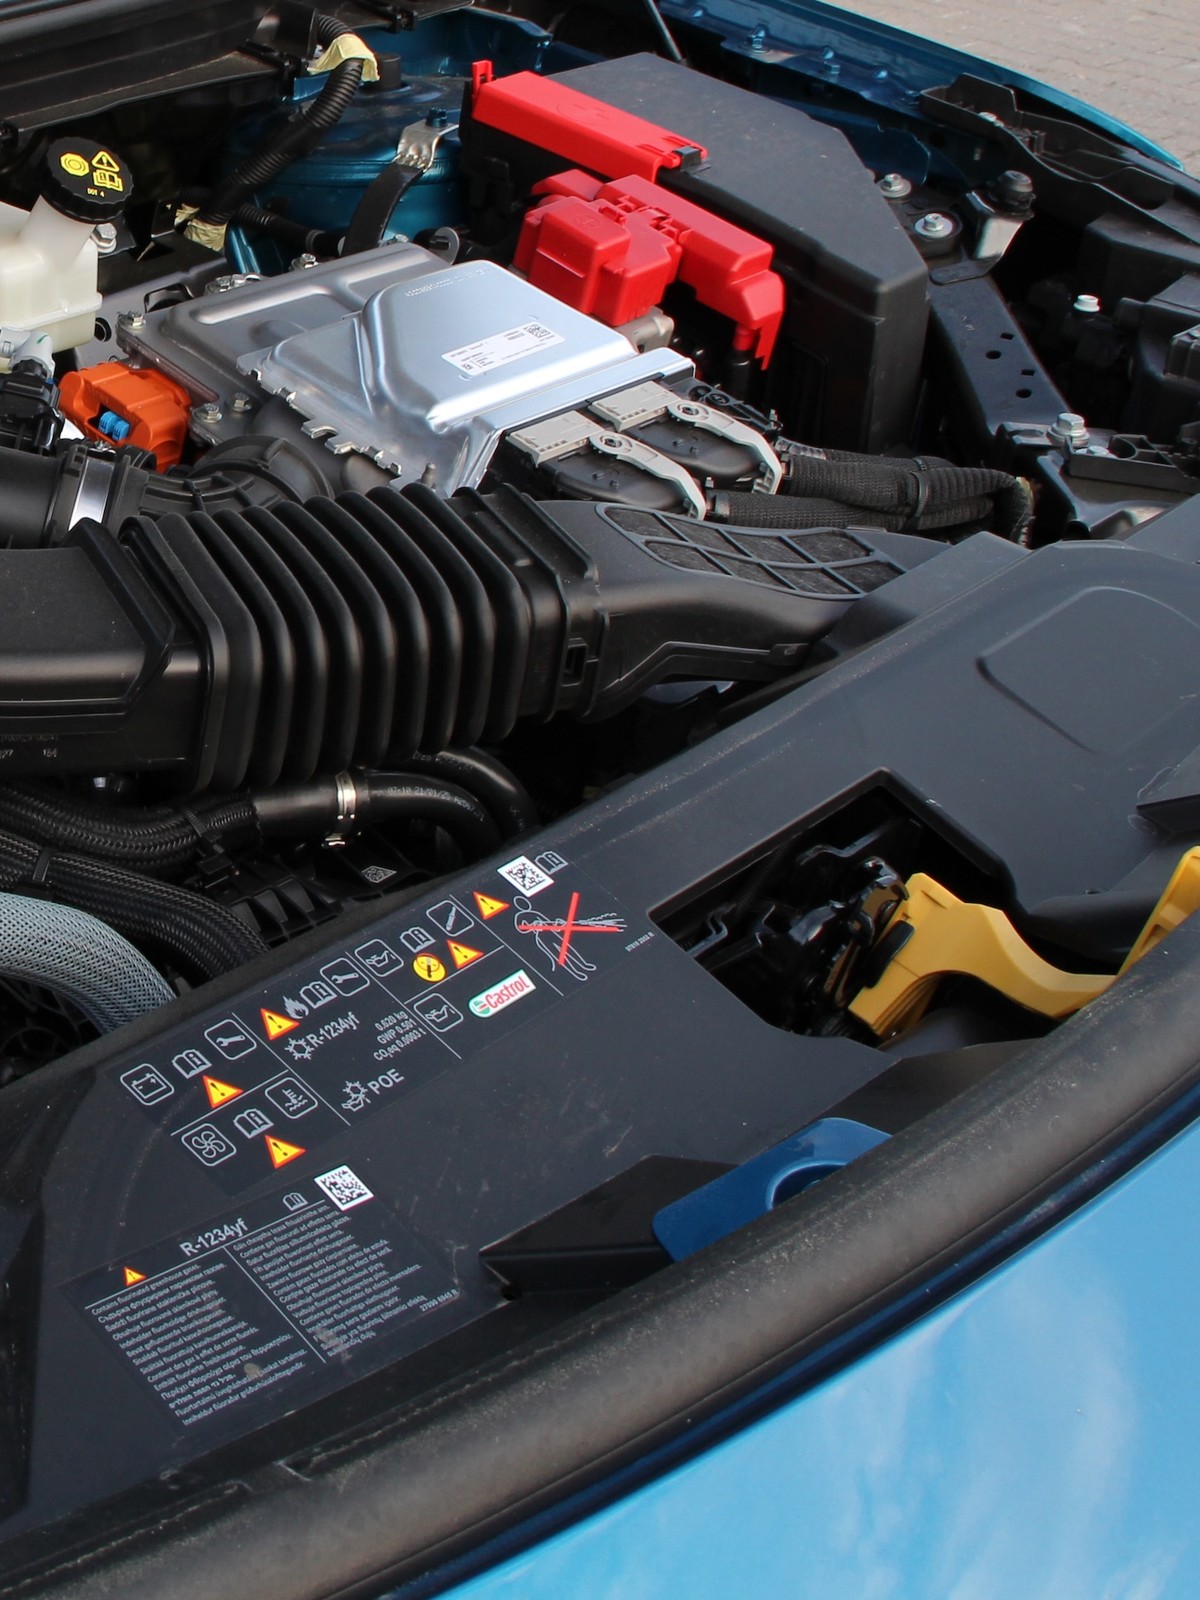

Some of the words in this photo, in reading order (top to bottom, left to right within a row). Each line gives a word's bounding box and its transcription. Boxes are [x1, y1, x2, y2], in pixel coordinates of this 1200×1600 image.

[484, 975, 531, 1009] Castrol
[305, 1011, 360, 1048] R-1234yf
[374, 1015, 397, 1031] 0.620
[394, 1010, 408, 1022] kg
[377, 1028, 397, 1044] GWP
[395, 1018, 417, 1034] 0.501
[395, 1029, 422, 1048] 0.0003
[418, 1027, 427, 1036] t
[367, 1068, 405, 1095] POE
[179, 1217, 249, 1257] R-1234yf
[91, 1301, 119, 1315] Contains
[117, 1285, 150, 1304] fluorinated
[149, 1271, 183, 1290] greenhouse
[182, 1264, 200, 1275] gases.
